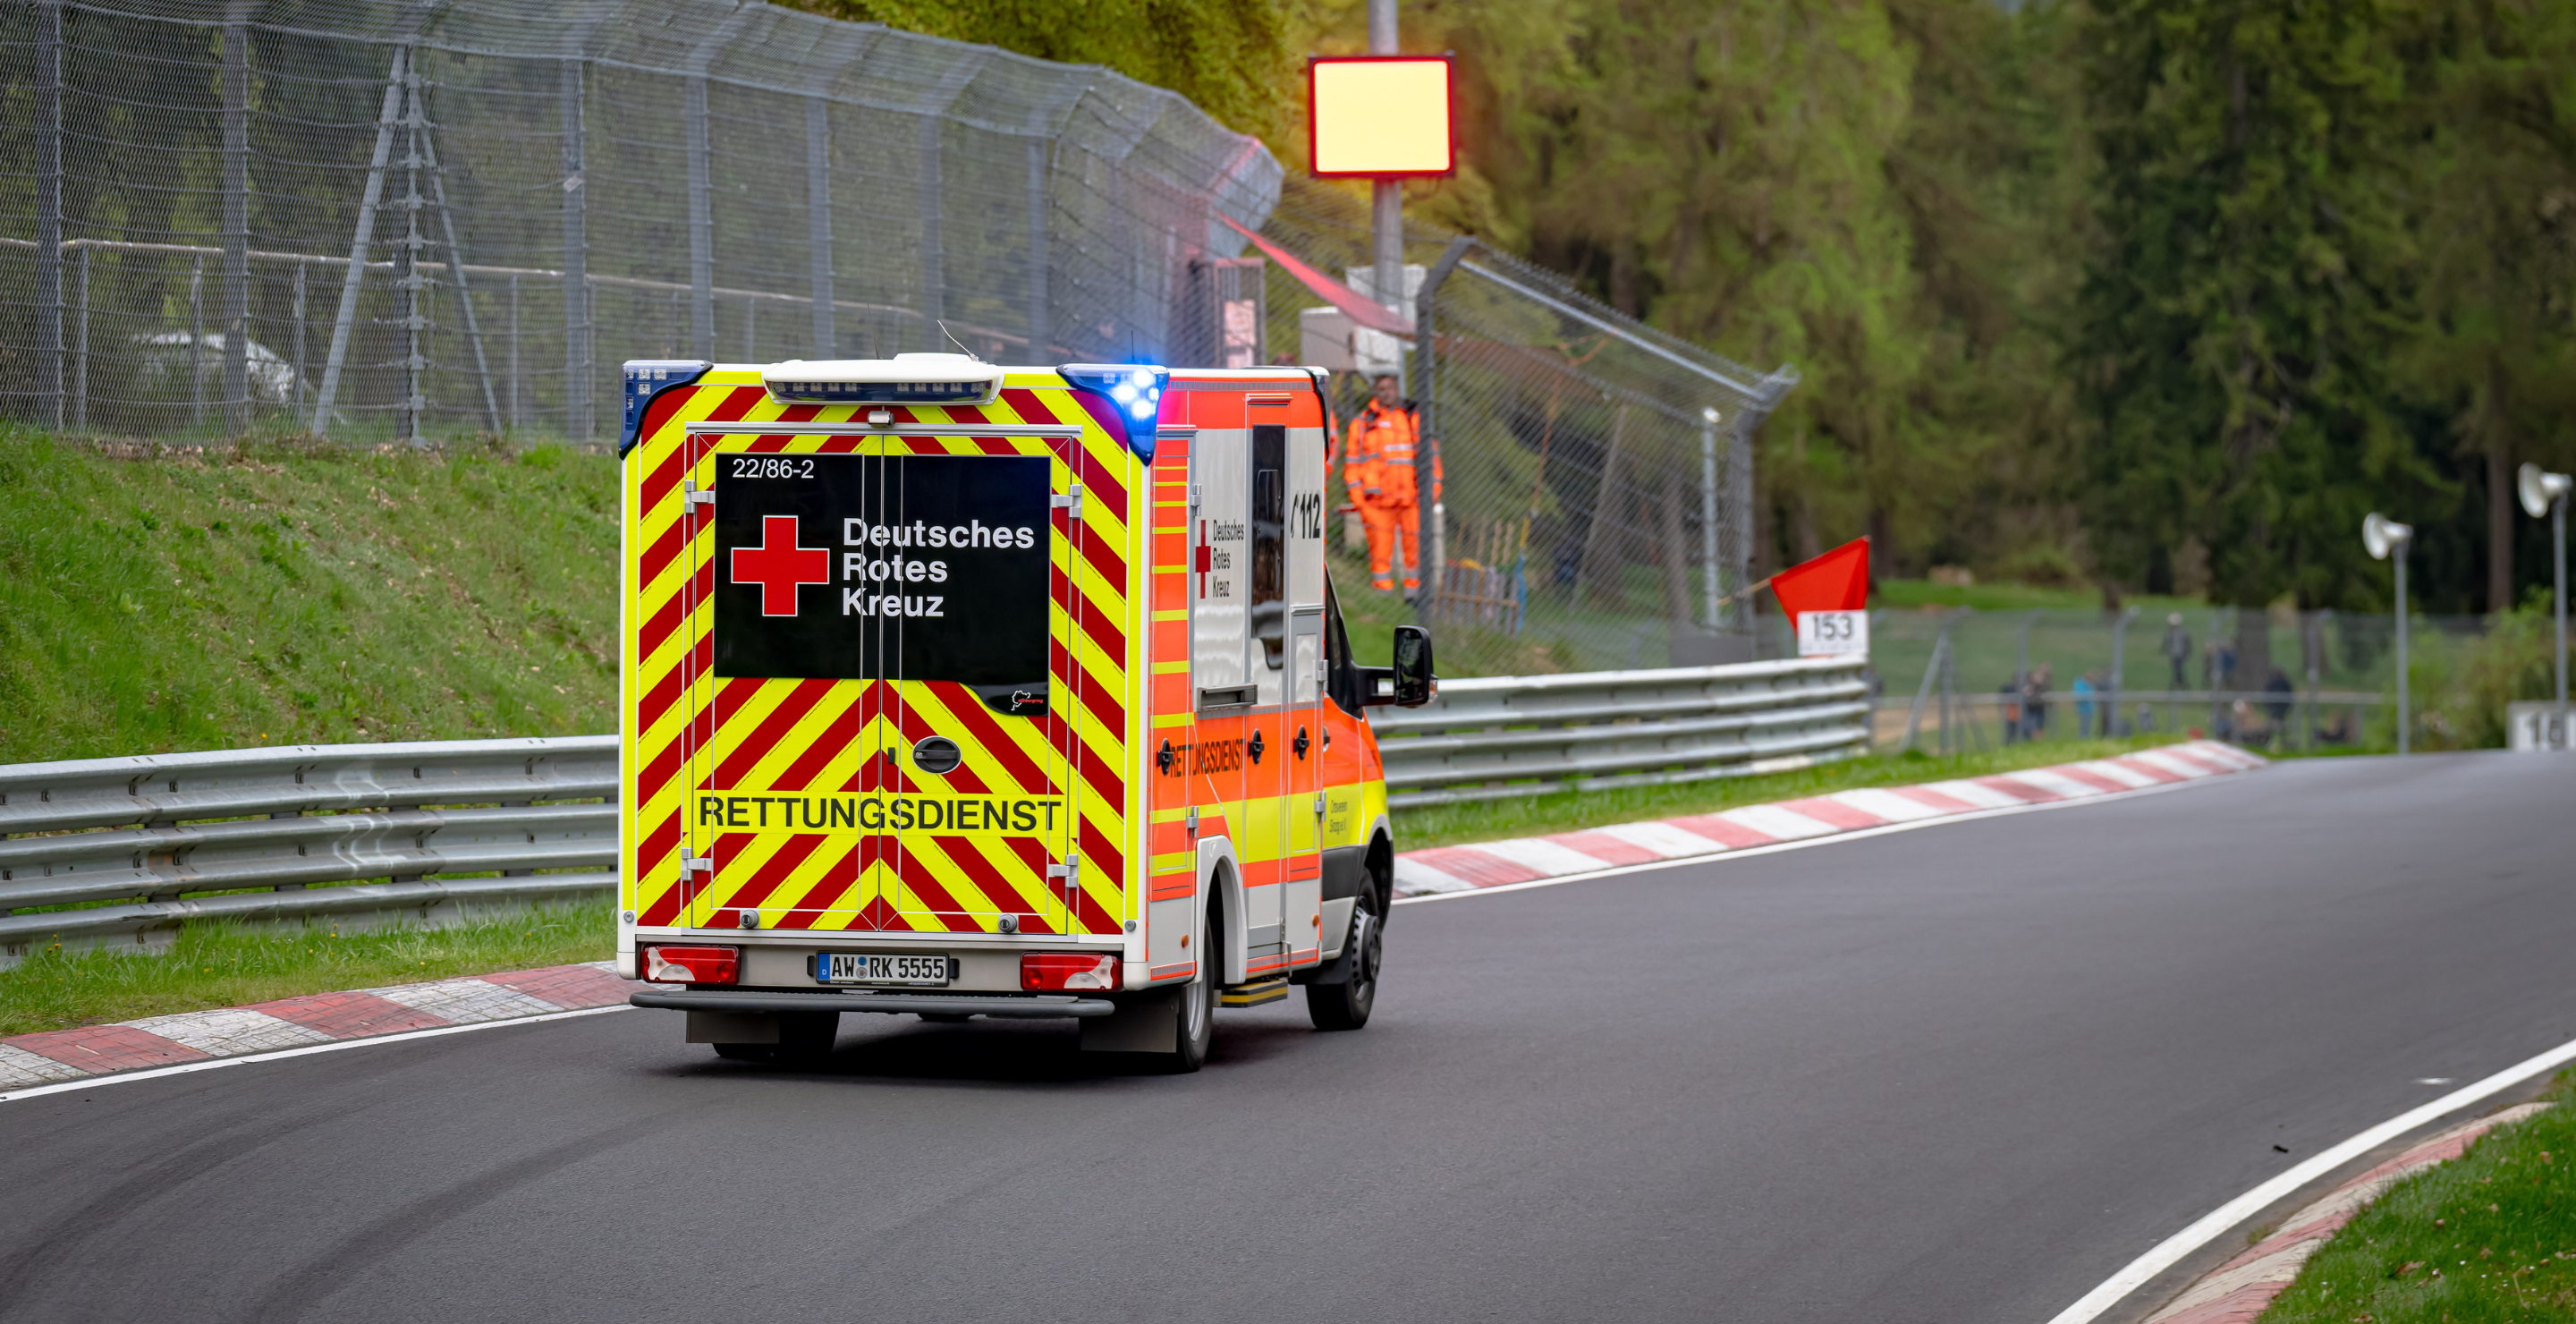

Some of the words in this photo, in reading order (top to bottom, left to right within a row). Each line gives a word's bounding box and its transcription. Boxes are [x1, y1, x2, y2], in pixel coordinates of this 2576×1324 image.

[732, 459, 815, 480] 22/86-2
[1300, 492, 1321, 539] 112
[843, 517, 1035, 549] Deutsches
[1213, 519, 1244, 542] Deutsches
[843, 552, 948, 582] Rotes
[1213, 547, 1231, 570] Rotes
[1212, 575, 1230, 598] Kreuz
[842, 587, 945, 618] Kreuz
[1812, 614, 1852, 641] 153
[1171, 738, 1245, 778] RETTUNGSDIENST
[699, 795, 1062, 833] RETTUNGSDIENST
[832, 956, 855, 977] AW
[869, 957, 894, 978] RK
[898, 958, 945, 979] 5555
